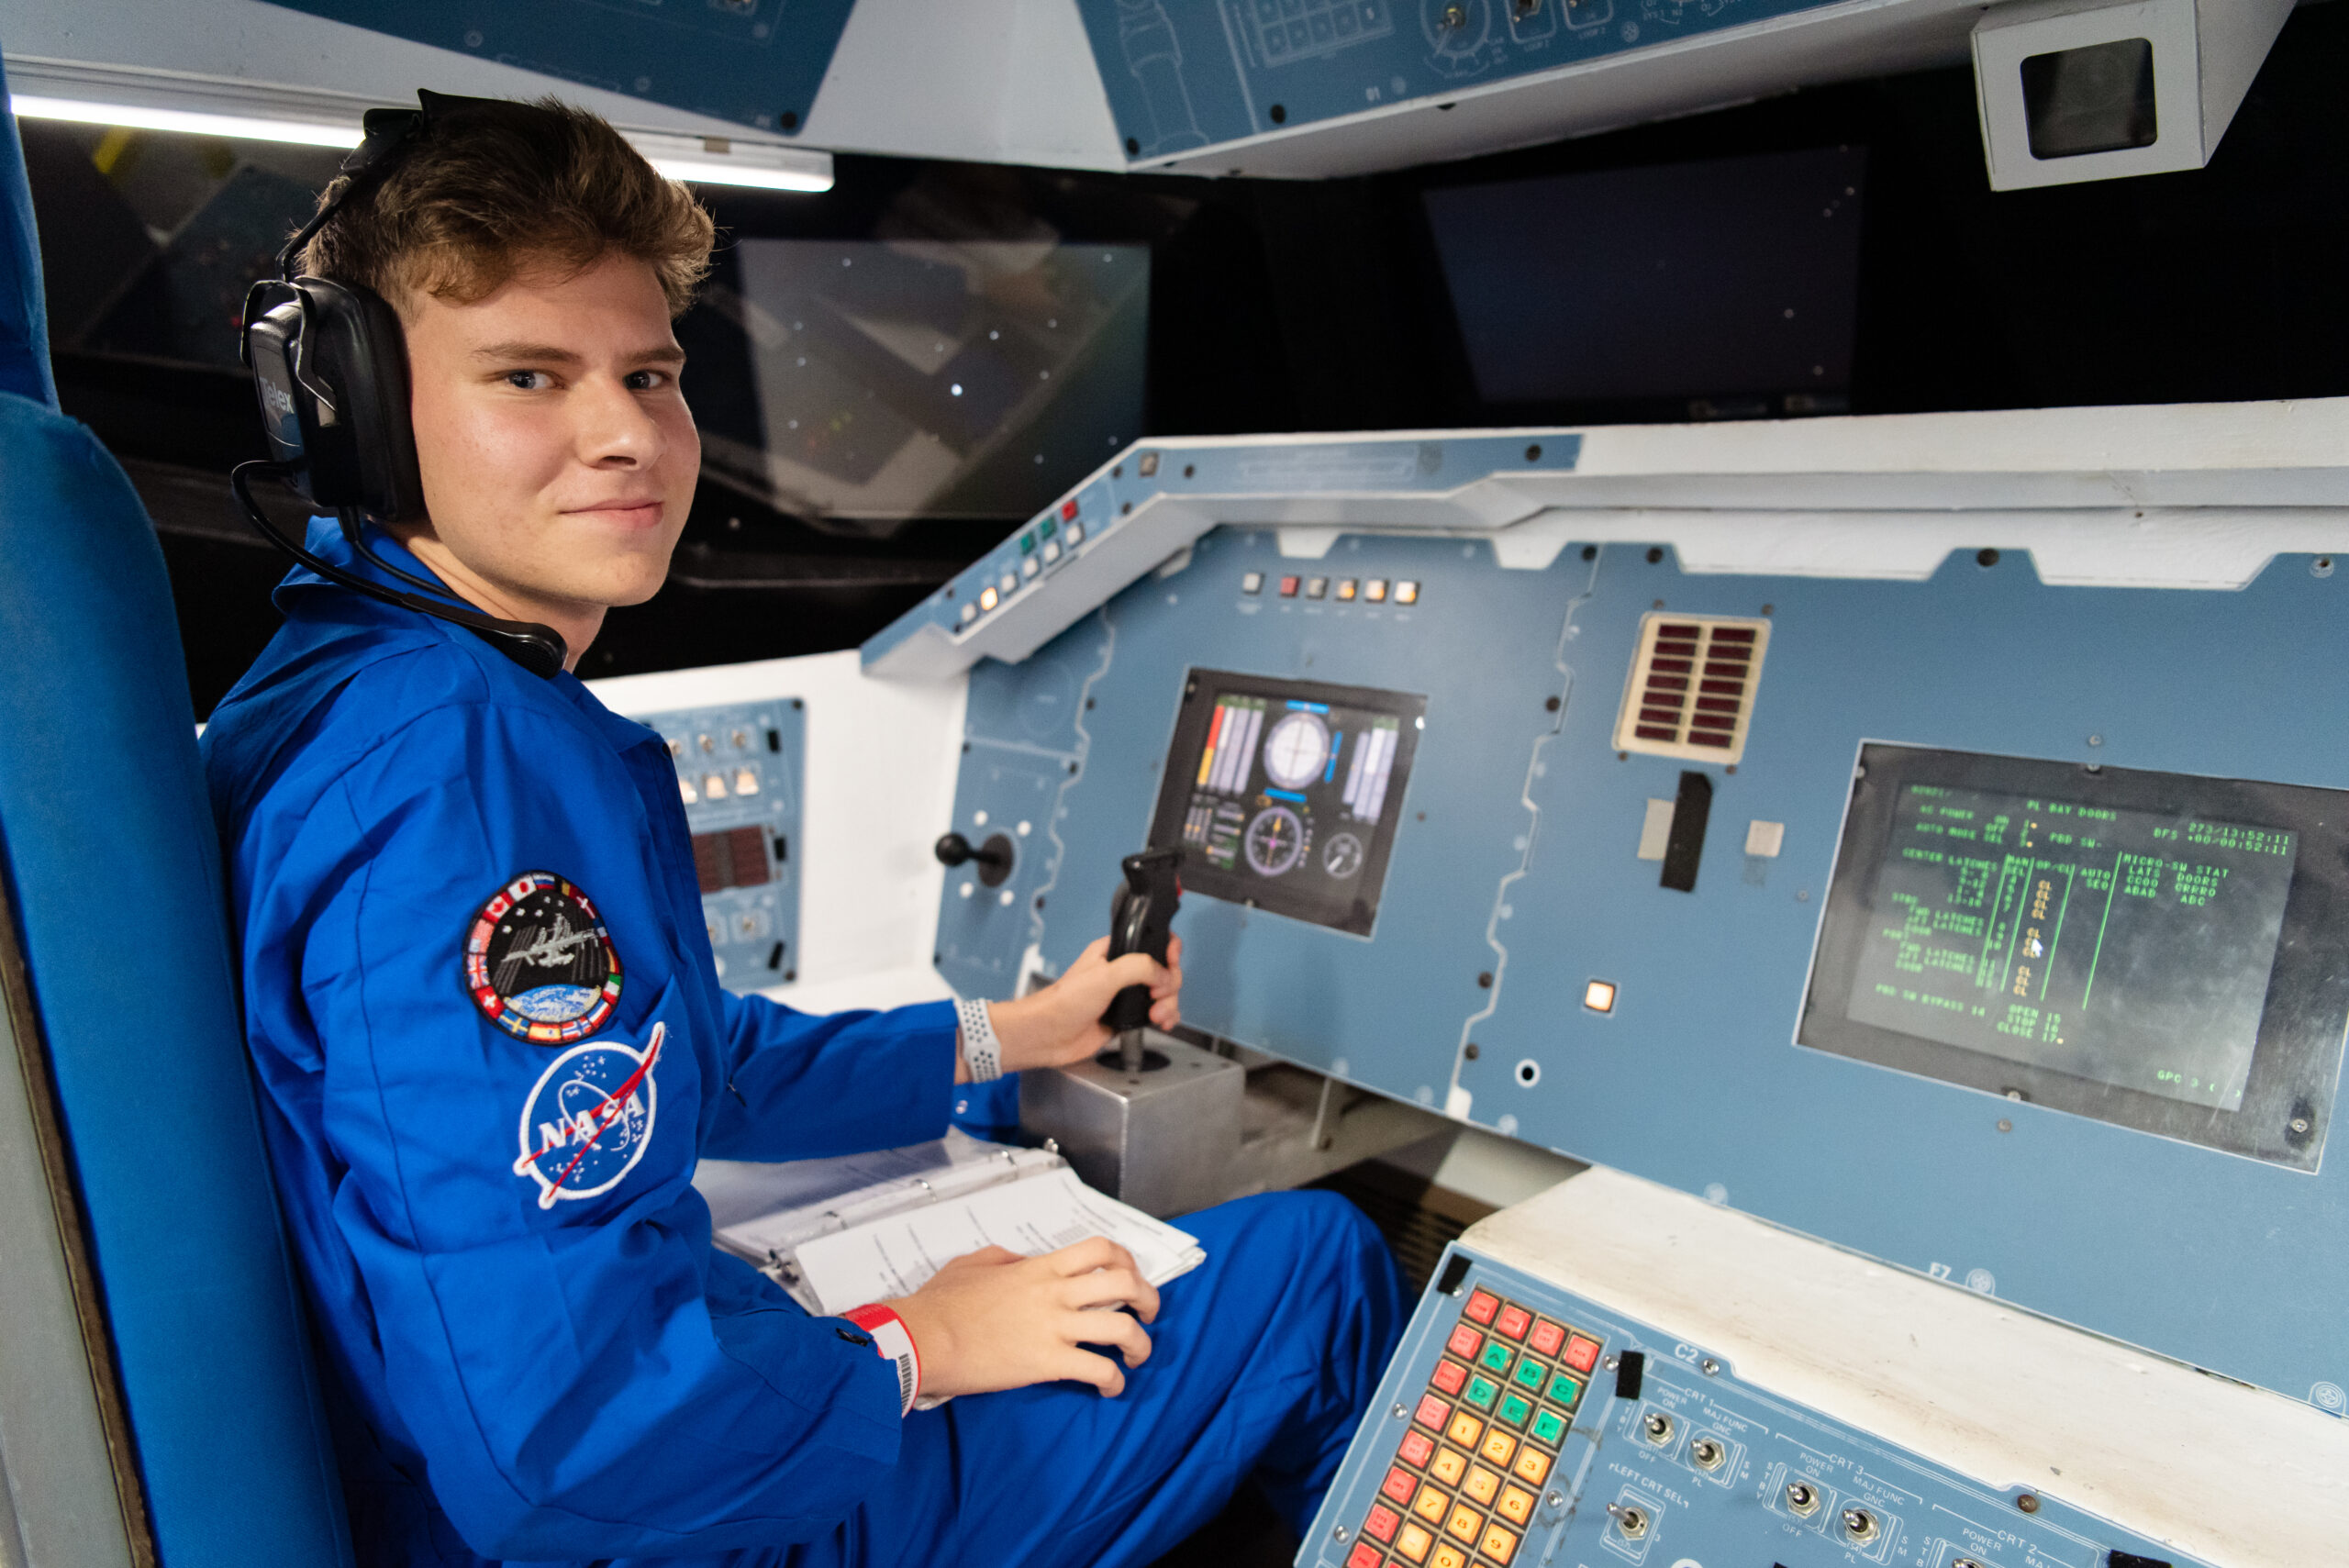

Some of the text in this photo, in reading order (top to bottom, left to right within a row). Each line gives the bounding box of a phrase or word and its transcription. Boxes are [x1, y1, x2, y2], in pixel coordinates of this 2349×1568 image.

[260, 375, 295, 415] Telex
[2048, 803, 2072, 815] BAY
[2077, 806, 2117, 821] DOORS
[1916, 822, 1944, 834] AUTO
[1948, 827, 1976, 840] MODE
[2188, 821, 2288, 845] 273/13:52:11
[1902, 848, 1997, 873] CENTER LATCHES
[2122, 853, 2229, 878] MICRO-SW STAT
[2080, 868, 2110, 880] AUTO
[2129, 865, 2218, 887] LATS DOORS
[2038, 880, 2053, 891] CL
[2036, 889, 2051, 901] CL
[2124, 885, 2206, 906] ABAB ABC
[2033, 898, 2048, 910] CL
[1935, 910, 1984, 927] LATCHES
[2032, 908, 2045, 920] CL
[1932, 919, 1982, 937] LATCHES
[2027, 927, 2041, 939] CL
[1926, 947, 1975, 965] LATCHES
[1924, 957, 1973, 974] LATCHES
[2018, 965, 2032, 977] CL
[2015, 975, 2029, 986] CL
[2013, 984, 2027, 996] CL
[1921, 994, 1965, 1012] BYPASS
[2009, 1004, 2039, 1018] OPEN
[2007, 1013, 2036, 1028] STOP
[1997, 1021, 2057, 1042] CLOSE 17
[2157, 1069, 2199, 1088] GPC 3
[539, 1090, 646, 1152] NASA
[1488, 1352, 1500, 1363] A
[1675, 1343, 1699, 1364] C2
[1523, 1366, 1536, 1379] B
[1474, 1386, 1486, 1398] D
[1555, 1384, 1569, 1396] C
[1657, 1386, 1687, 1405] POWER
[1684, 1387, 1707, 1403] CRT
[1508, 1405, 1520, 1416] E
[1662, 1398, 1676, 1409] ON
[1541, 1419, 1554, 1430] F
[1703, 1407, 1748, 1432] MAJ FUNC
[1460, 1425, 1467, 1435] 1
[1712, 1421, 1732, 1436] GNC
[1491, 1441, 1504, 1453] 2
[1639, 1450, 1656, 1463] OFF
[1799, 1452, 1834, 1473] POWER
[1441, 1461, 1452, 1472] 4
[1524, 1460, 1537, 1471] 3
[1829, 1453, 1865, 1475] CRT 3
[1806, 1465, 1820, 1478] ON
[1474, 1479, 1486, 1491] 5
[1614, 1464, 1684, 1506] LEFT CRT SEL
[1692, 1476, 1703, 1487] PL
[1853, 1475, 1905, 1506] MAJ FUNC
[1425, 1499, 1437, 1507] 7
[1508, 1499, 1520, 1511] 6
[1864, 1492, 1886, 1508] GNC
[1456, 1518, 1468, 1529] 8
[1782, 1523, 1803, 1538] OFF
[1490, 1539, 1501, 1550] 9
[1962, 1528, 2002, 1551] POWER
[1997, 1529, 2038, 1555] CRT 2
[1970, 1542, 1987, 1556] ON
[1441, 1556, 1452, 1567] 0
[1844, 1551, 1856, 1564] PL
[2025, 1556, 2051, 1568] MA
